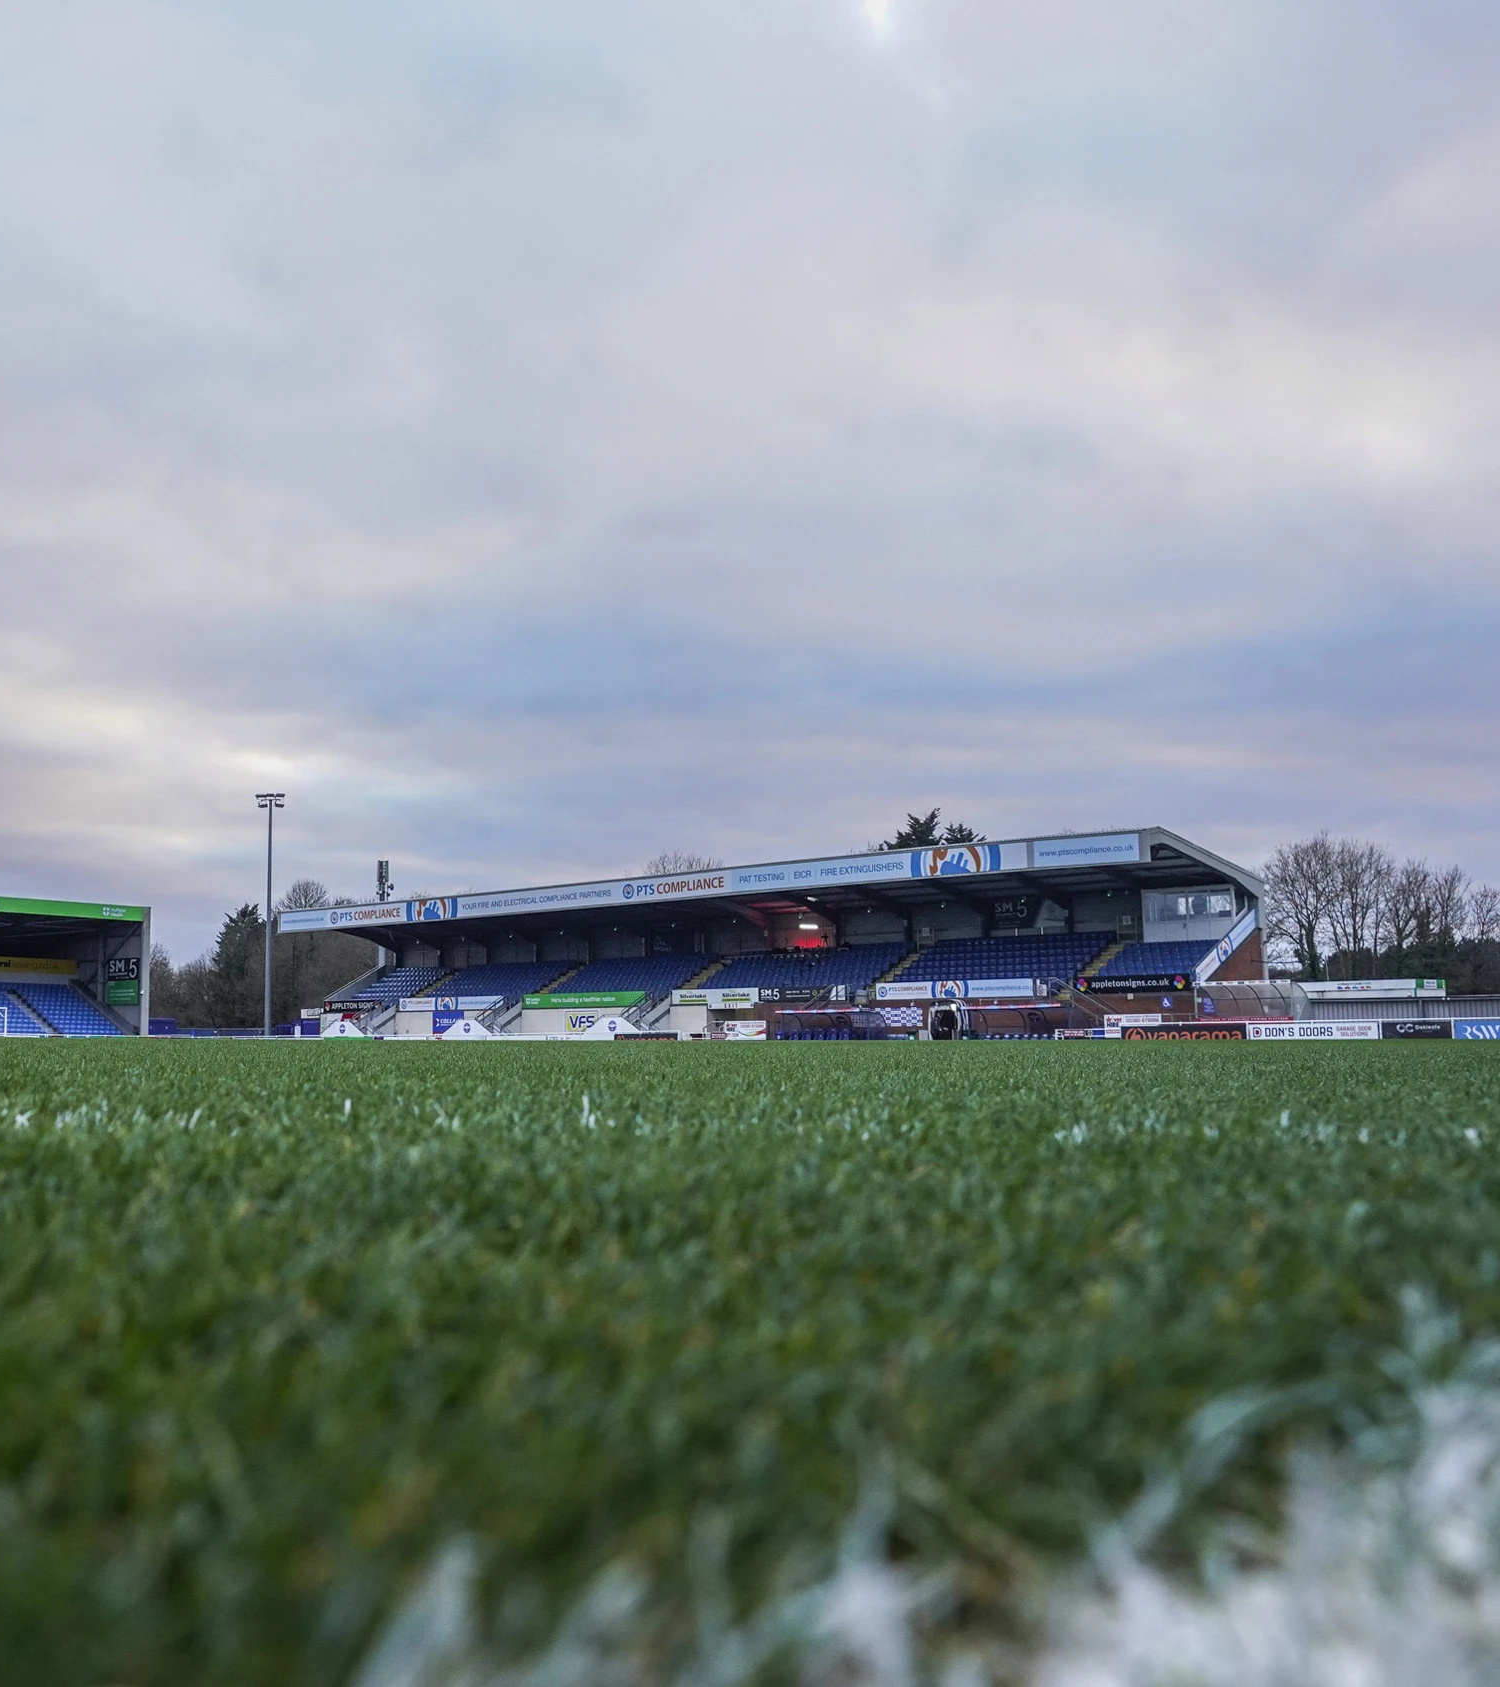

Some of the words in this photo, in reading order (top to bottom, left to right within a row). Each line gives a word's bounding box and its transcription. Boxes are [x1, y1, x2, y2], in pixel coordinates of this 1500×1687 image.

[1038, 843, 1134, 857] www.ptscompliance.co.uk
[739, 875, 752, 884] PAT
[753, 872, 785, 882] TESTING
[793, 871, 811, 880] EICR
[820, 868, 837, 877] FIRE
[839, 862, 904, 876] EXTINGUISHERS
[636, 884, 655, 896] PTS
[656, 876, 725, 895] COMPLIANCE
[491, 900, 503, 908] AND
[504, 896, 538, 907] ELECTRICAL
[539, 892, 578, 903] COMPLIANCE
[578, 889, 612, 900] PARTNERS
[340, 911, 353, 921] PTS
[354, 907, 401, 920] COMPLIANCE
[109, 959, 125, 973] SM
[129, 958, 138, 978] 5
[1091, 978, 1170, 989] appletonsigns.co.uk
[760, 988, 772, 996] SM
[773, 988, 780, 1000] 5
[331, 1002, 358, 1010] APPLETON
[569, 1015, 595, 1029] VFS
[1147, 1030, 1243, 1040] vanarama
[1264, 1027, 1295, 1037] DON'S
[1298, 1026, 1334, 1037] DOORS
